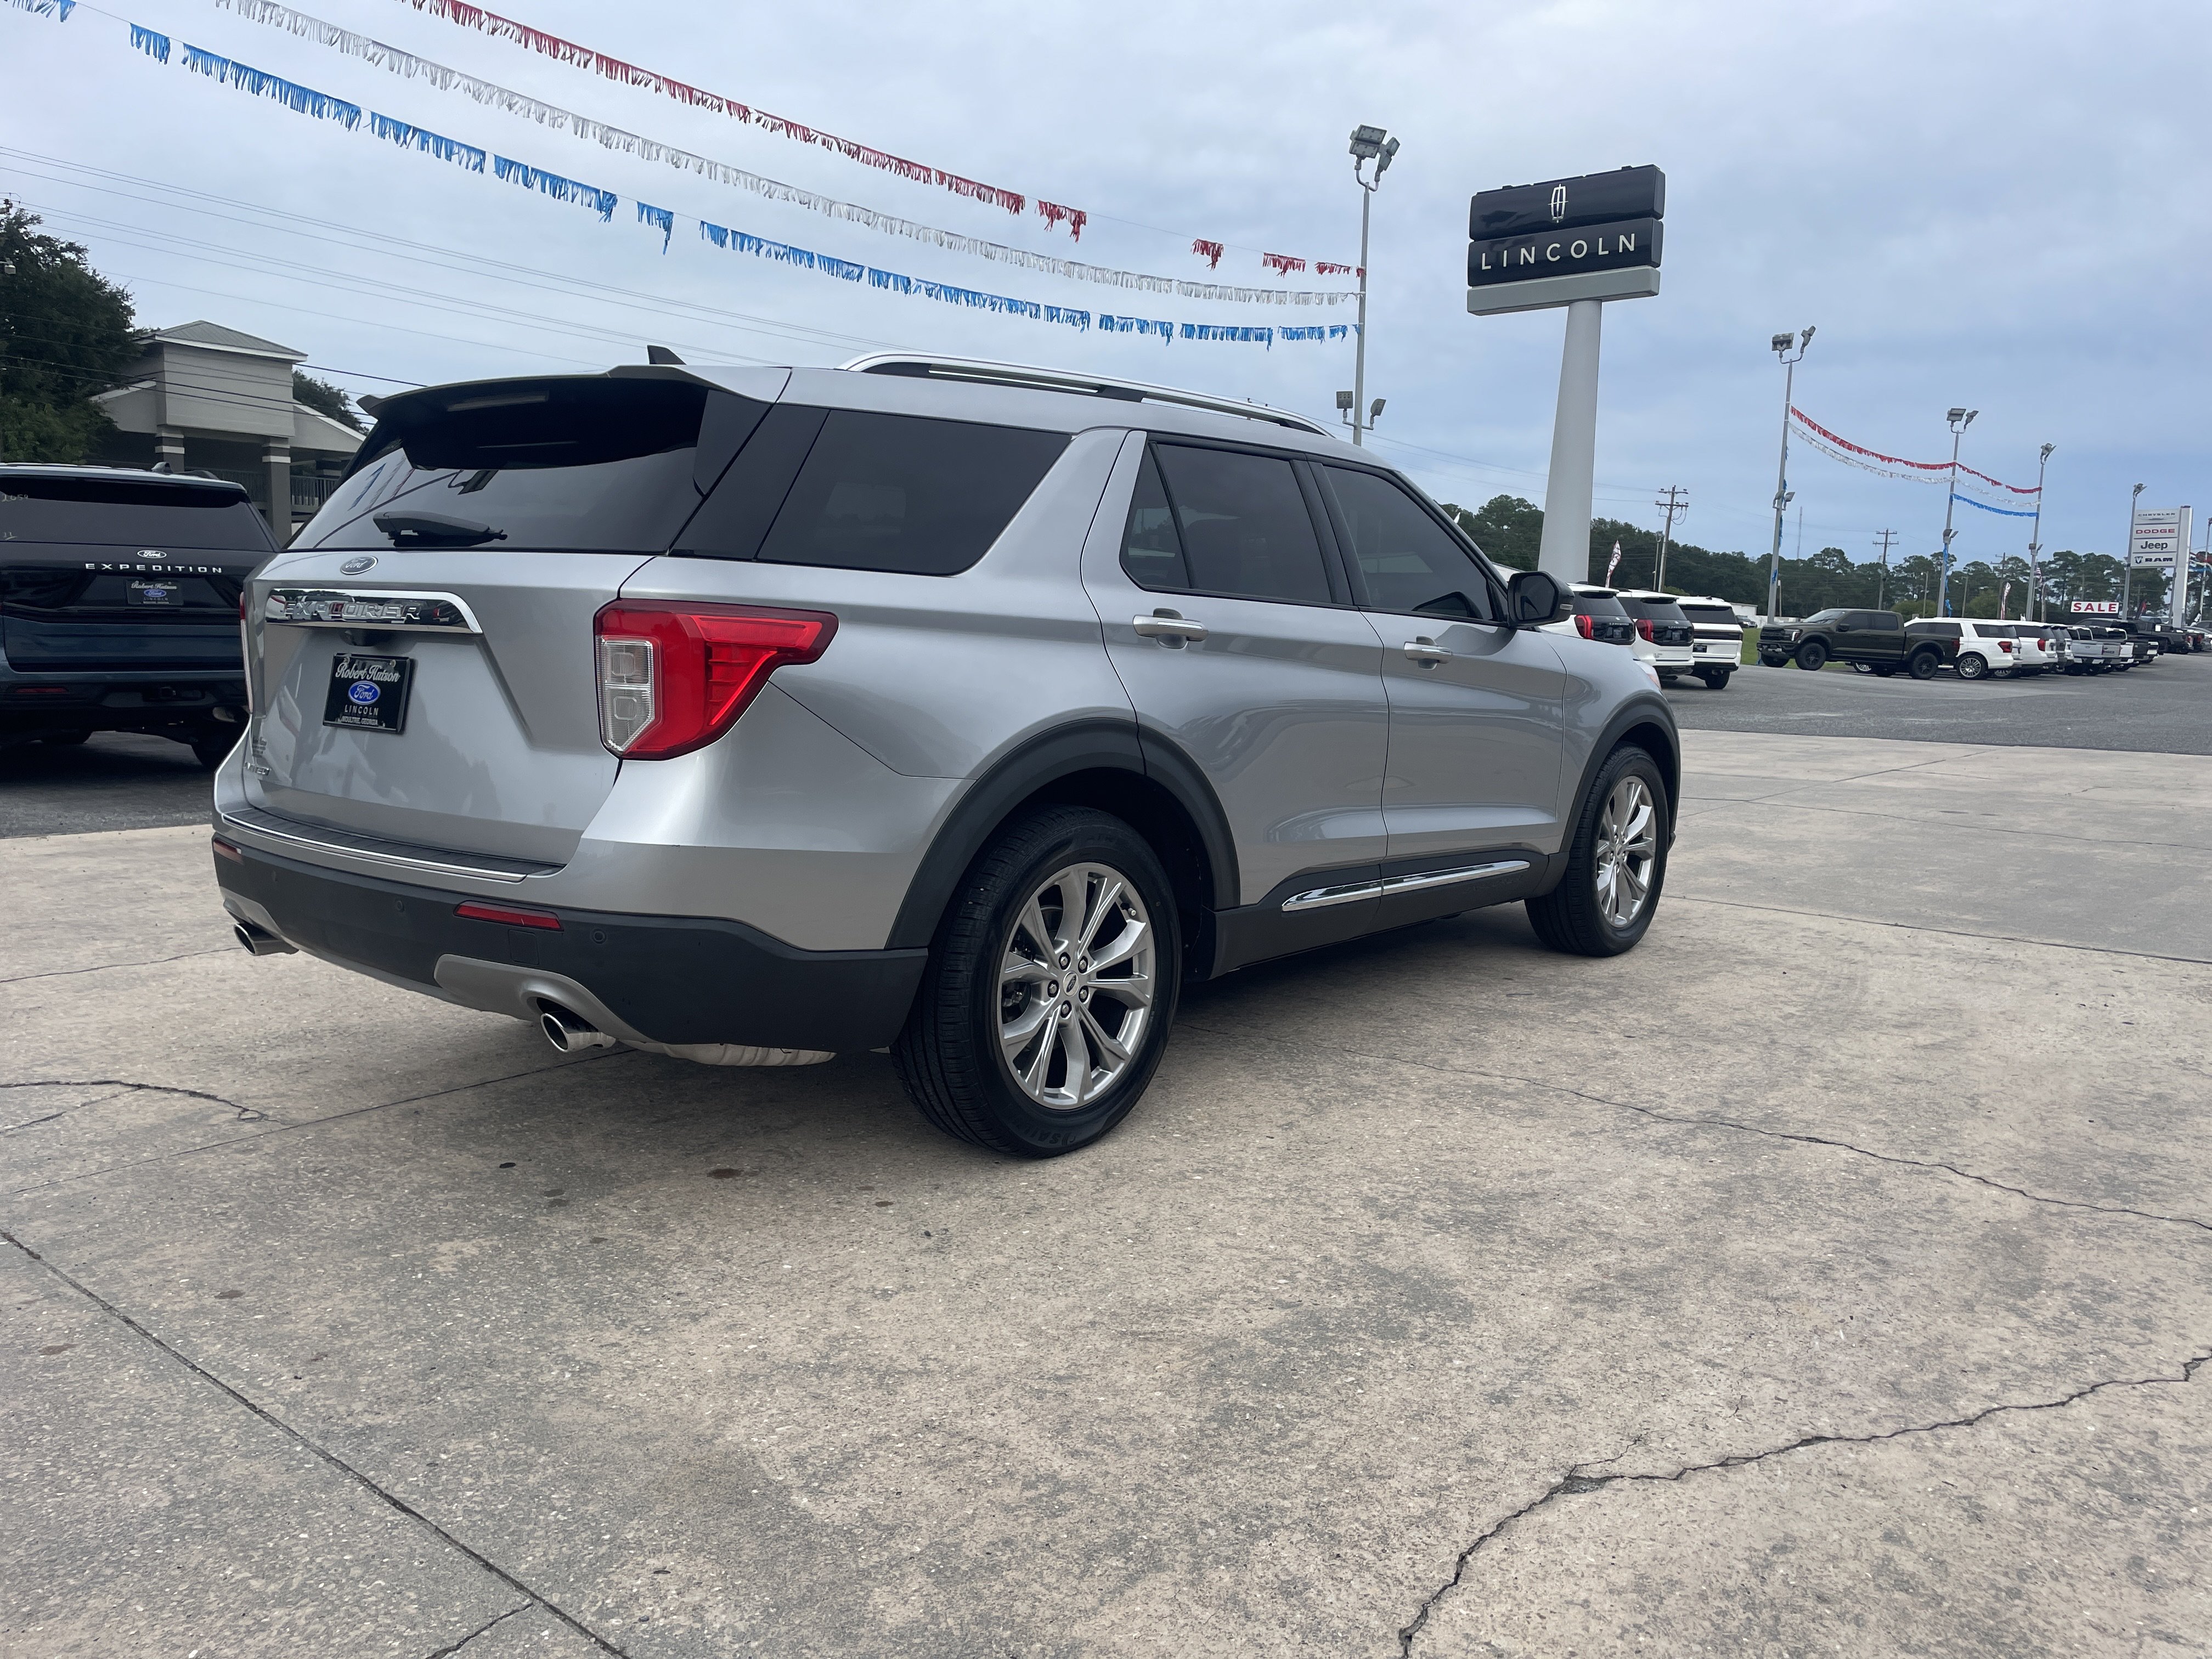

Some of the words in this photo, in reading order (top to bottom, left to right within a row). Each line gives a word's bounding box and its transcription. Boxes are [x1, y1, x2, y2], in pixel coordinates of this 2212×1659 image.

[1481, 233, 1635, 270] LINCOLN
[2140, 540, 2168, 551] Jeep
[85, 563, 222, 574] EXPEDITION
[284, 601, 421, 620] EXPLORER
[2073, 602, 2117, 612] SALE
[335, 662, 368, 680] Robert
[366, 665, 401, 682] Hutson
[344, 704, 379, 716] LINCOLN
